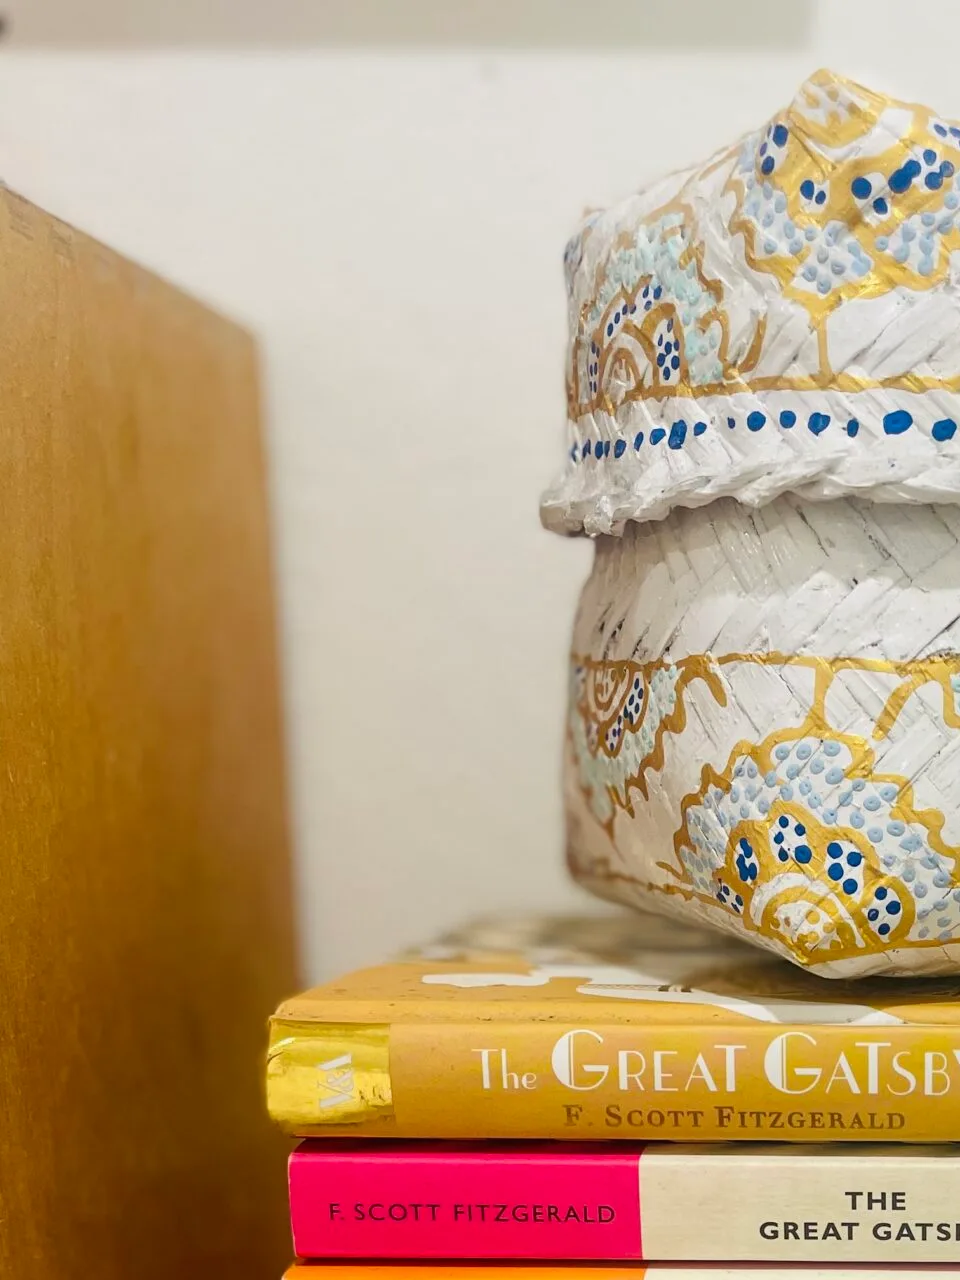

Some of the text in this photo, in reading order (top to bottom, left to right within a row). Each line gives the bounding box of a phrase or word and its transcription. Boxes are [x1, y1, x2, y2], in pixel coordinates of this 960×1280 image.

[472, 1048, 536, 1089] The
[551, 1030, 746, 1092] GREAT
[565, 1105, 904, 1129] F. SCOTT FITZGERALD
[845, 1192, 905, 1210] THE
[329, 1203, 614, 1222] F. SCOTT FITZGERALD
[760, 1222, 859, 1240] GREAT
